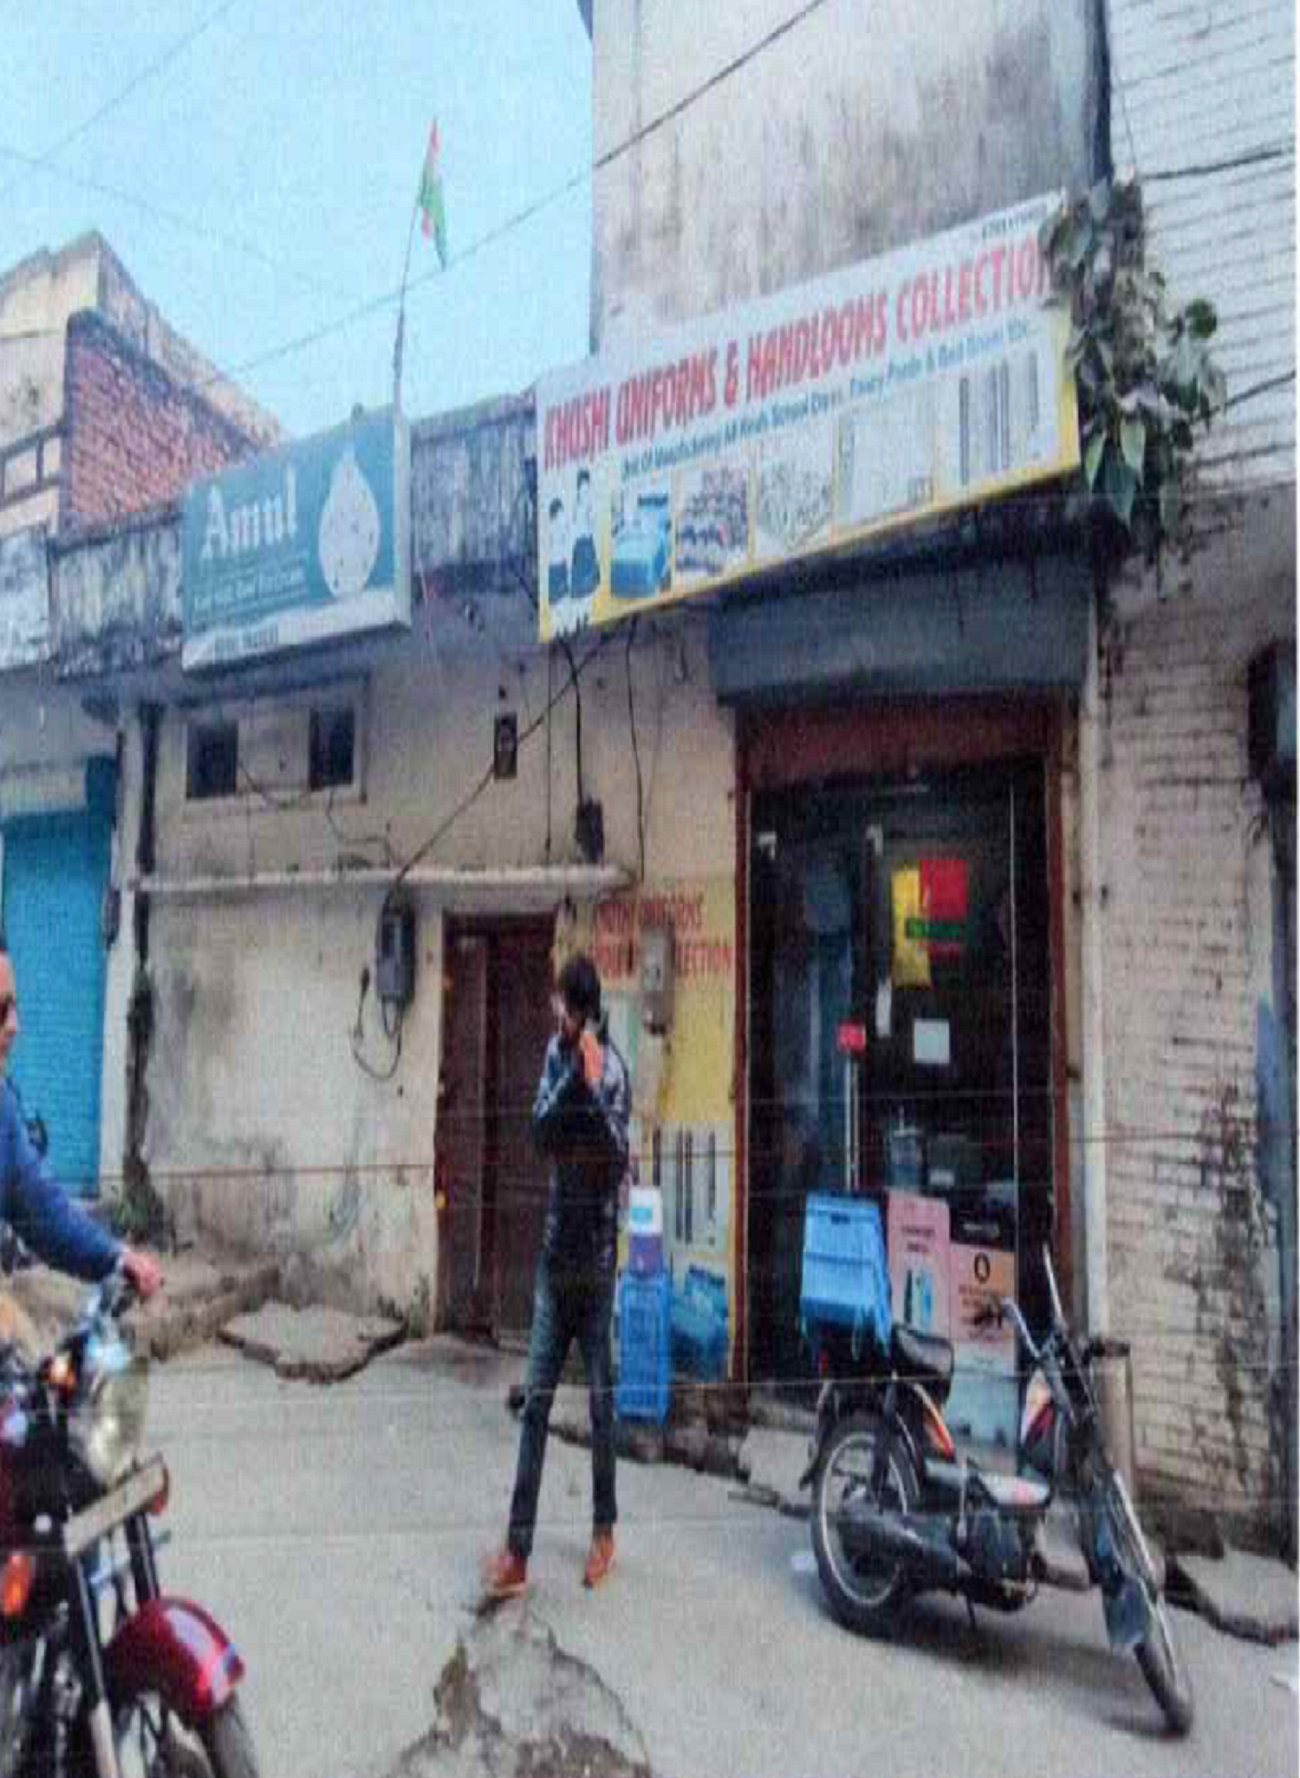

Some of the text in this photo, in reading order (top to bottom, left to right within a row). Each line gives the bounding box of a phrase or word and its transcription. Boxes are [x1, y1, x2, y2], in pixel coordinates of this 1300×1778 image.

[544, 383, 610, 470] KHUSHI
[724, 338, 738, 410] &
[201, 461, 298, 559] Amul
